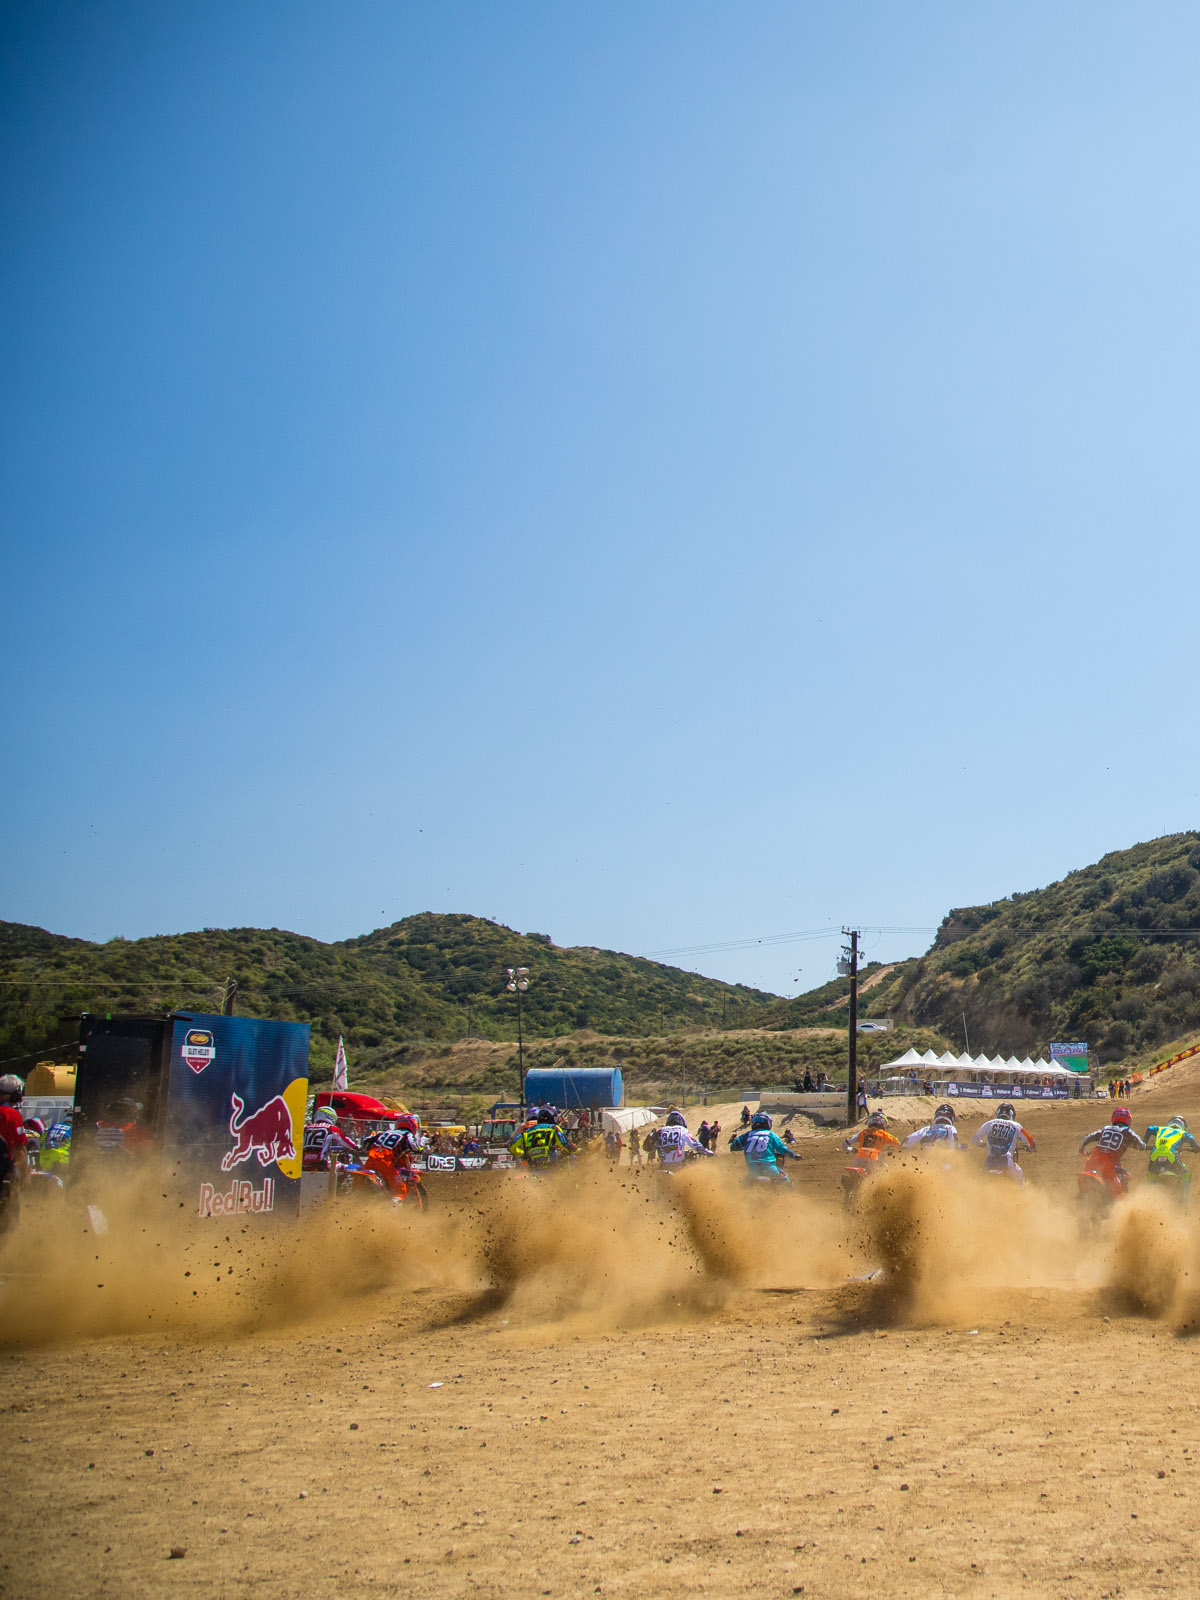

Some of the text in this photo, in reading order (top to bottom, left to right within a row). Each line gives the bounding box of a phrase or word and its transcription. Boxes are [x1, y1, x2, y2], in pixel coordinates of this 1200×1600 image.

[661, 1131, 679, 1146] 342
[991, 1123, 1011, 1140] 677
[1100, 1130, 1123, 1150] 29
[746, 1135, 770, 1152] 78
[428, 1155, 456, 1171] WPS
[199, 1177, 275, 1217] Red Bull
